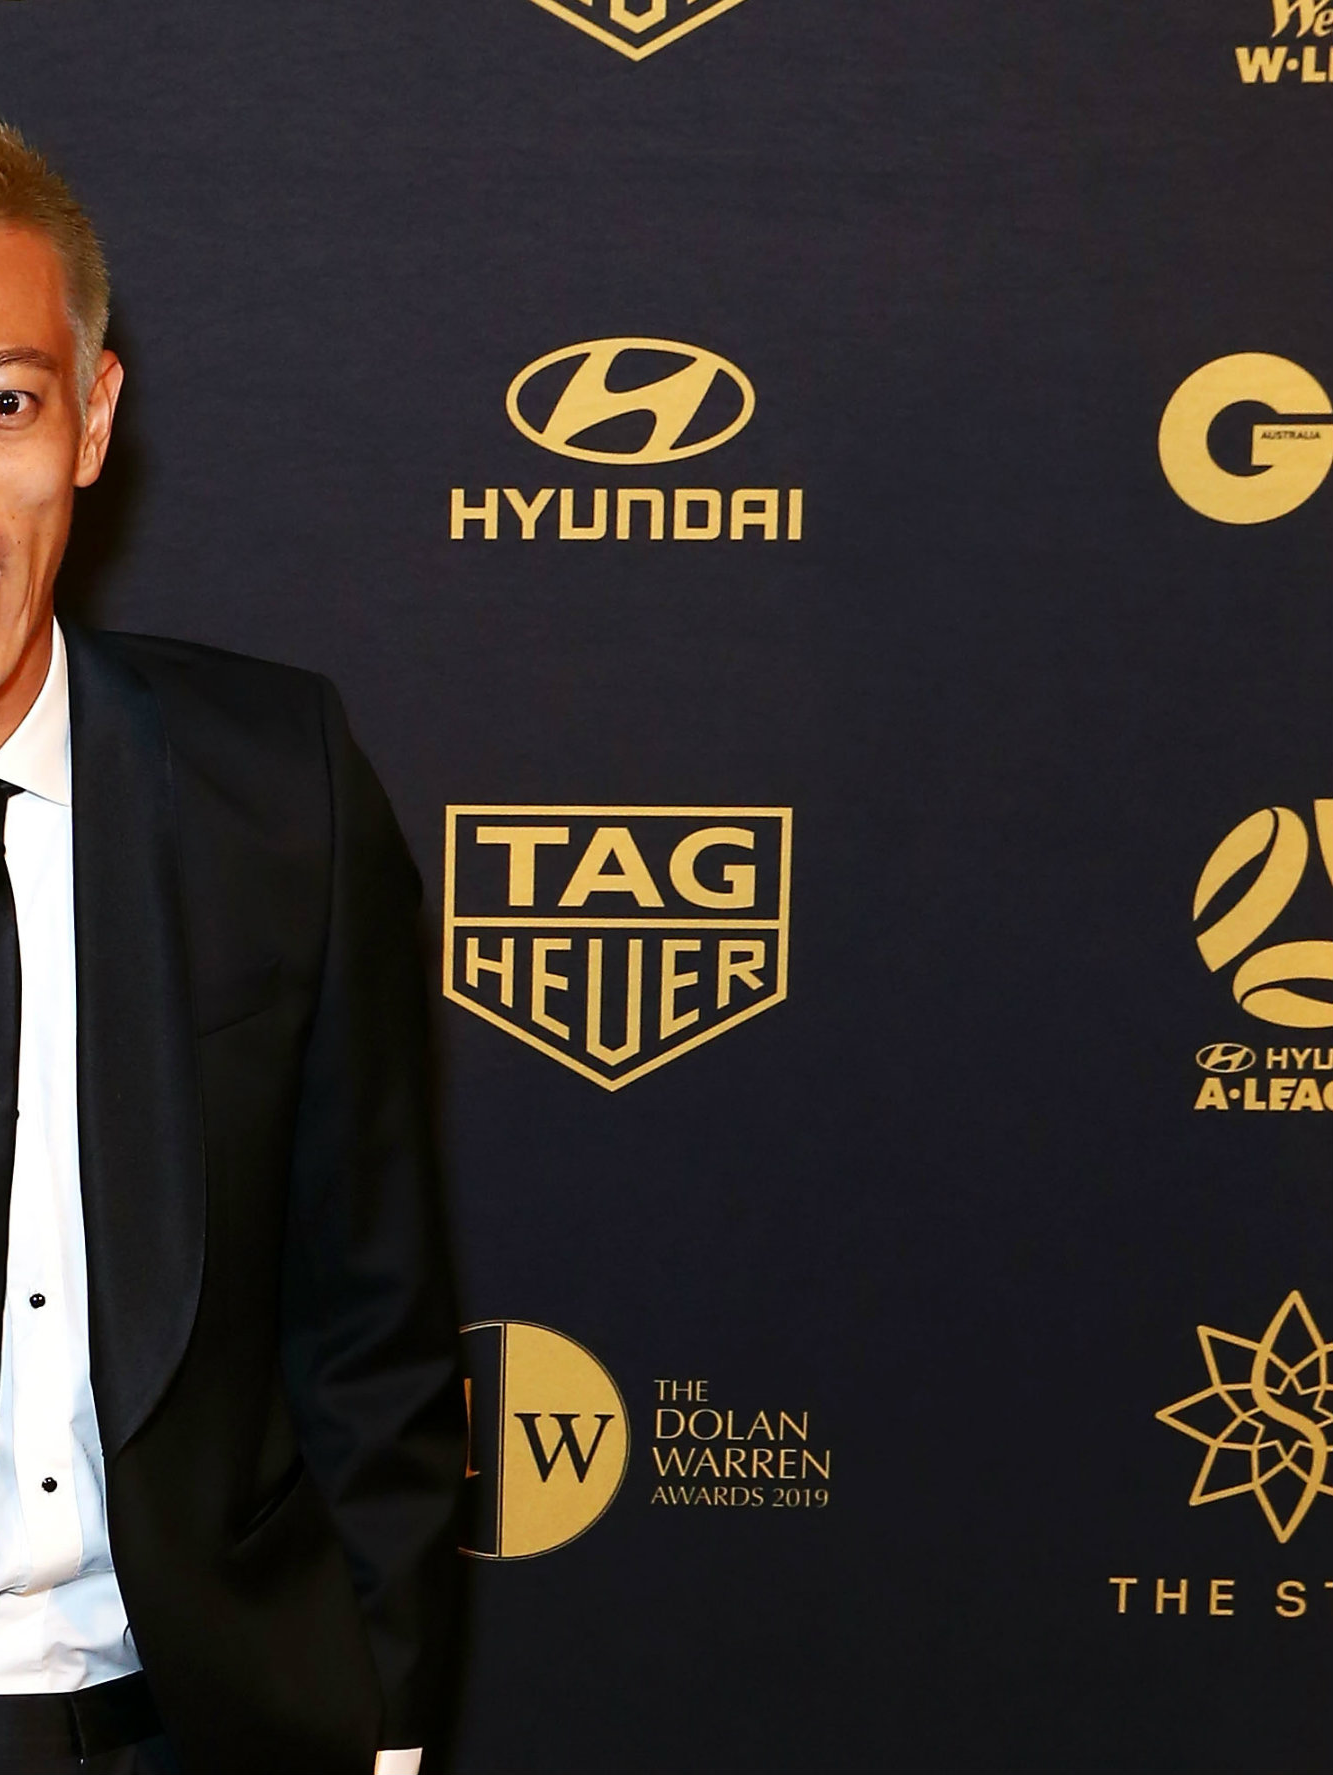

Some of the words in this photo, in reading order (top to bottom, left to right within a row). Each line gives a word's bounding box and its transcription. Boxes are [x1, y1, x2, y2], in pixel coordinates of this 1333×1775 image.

[1261, 430, 1321, 440] AUSTRALIA
[449, 487, 804, 541] HYUNDAI
[475, 825, 756, 910] TAG
[466, 936, 766, 1067] HEUER
[653, 1379, 709, 1402] THE
[655, 1408, 808, 1441] DOLAN
[652, 1446, 831, 1480] WARREN
[651, 1486, 764, 1507] AWARDS
[772, 1487, 829, 1508] 2019
[1108, 1577, 1236, 1616] THE
[1274, 1579, 1333, 1619] S
